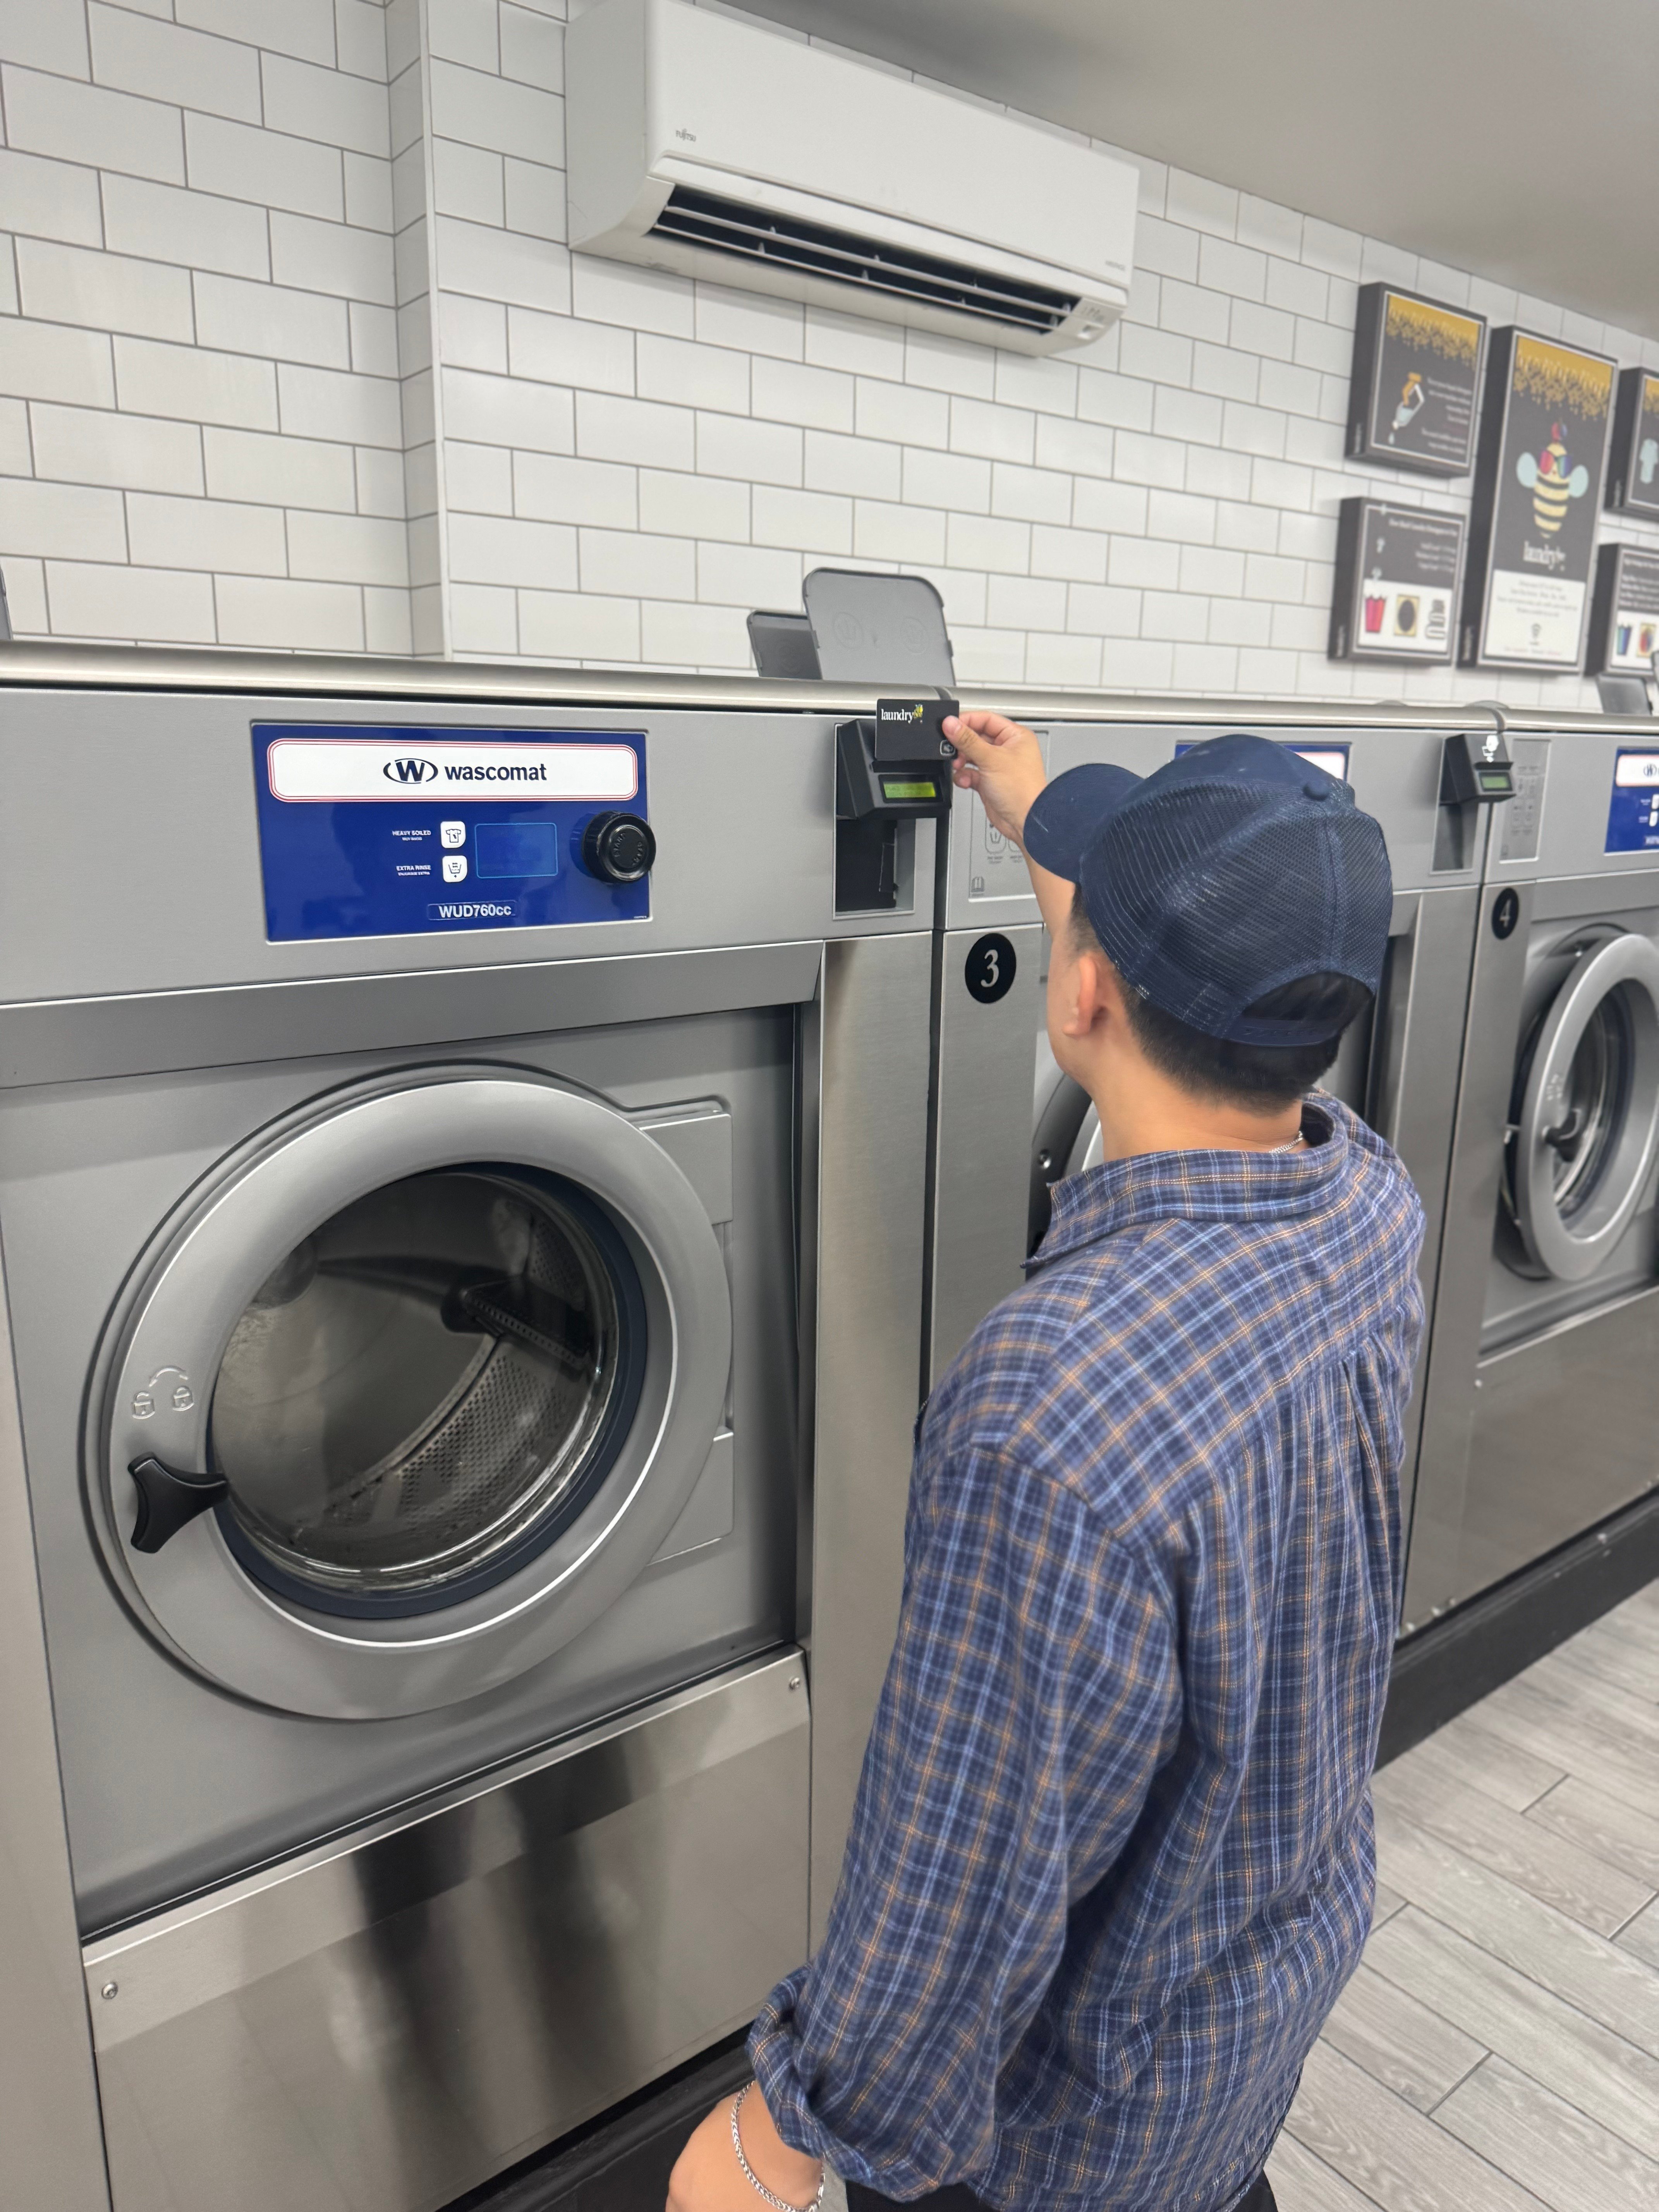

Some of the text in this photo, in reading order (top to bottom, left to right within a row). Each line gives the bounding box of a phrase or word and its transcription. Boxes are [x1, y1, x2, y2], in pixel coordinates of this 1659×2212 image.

[444, 763, 547, 781] wascomat
[438, 904, 512, 918] WUD760cc
[1499, 899, 1511, 928] 4
[981, 949, 999, 988] 3
